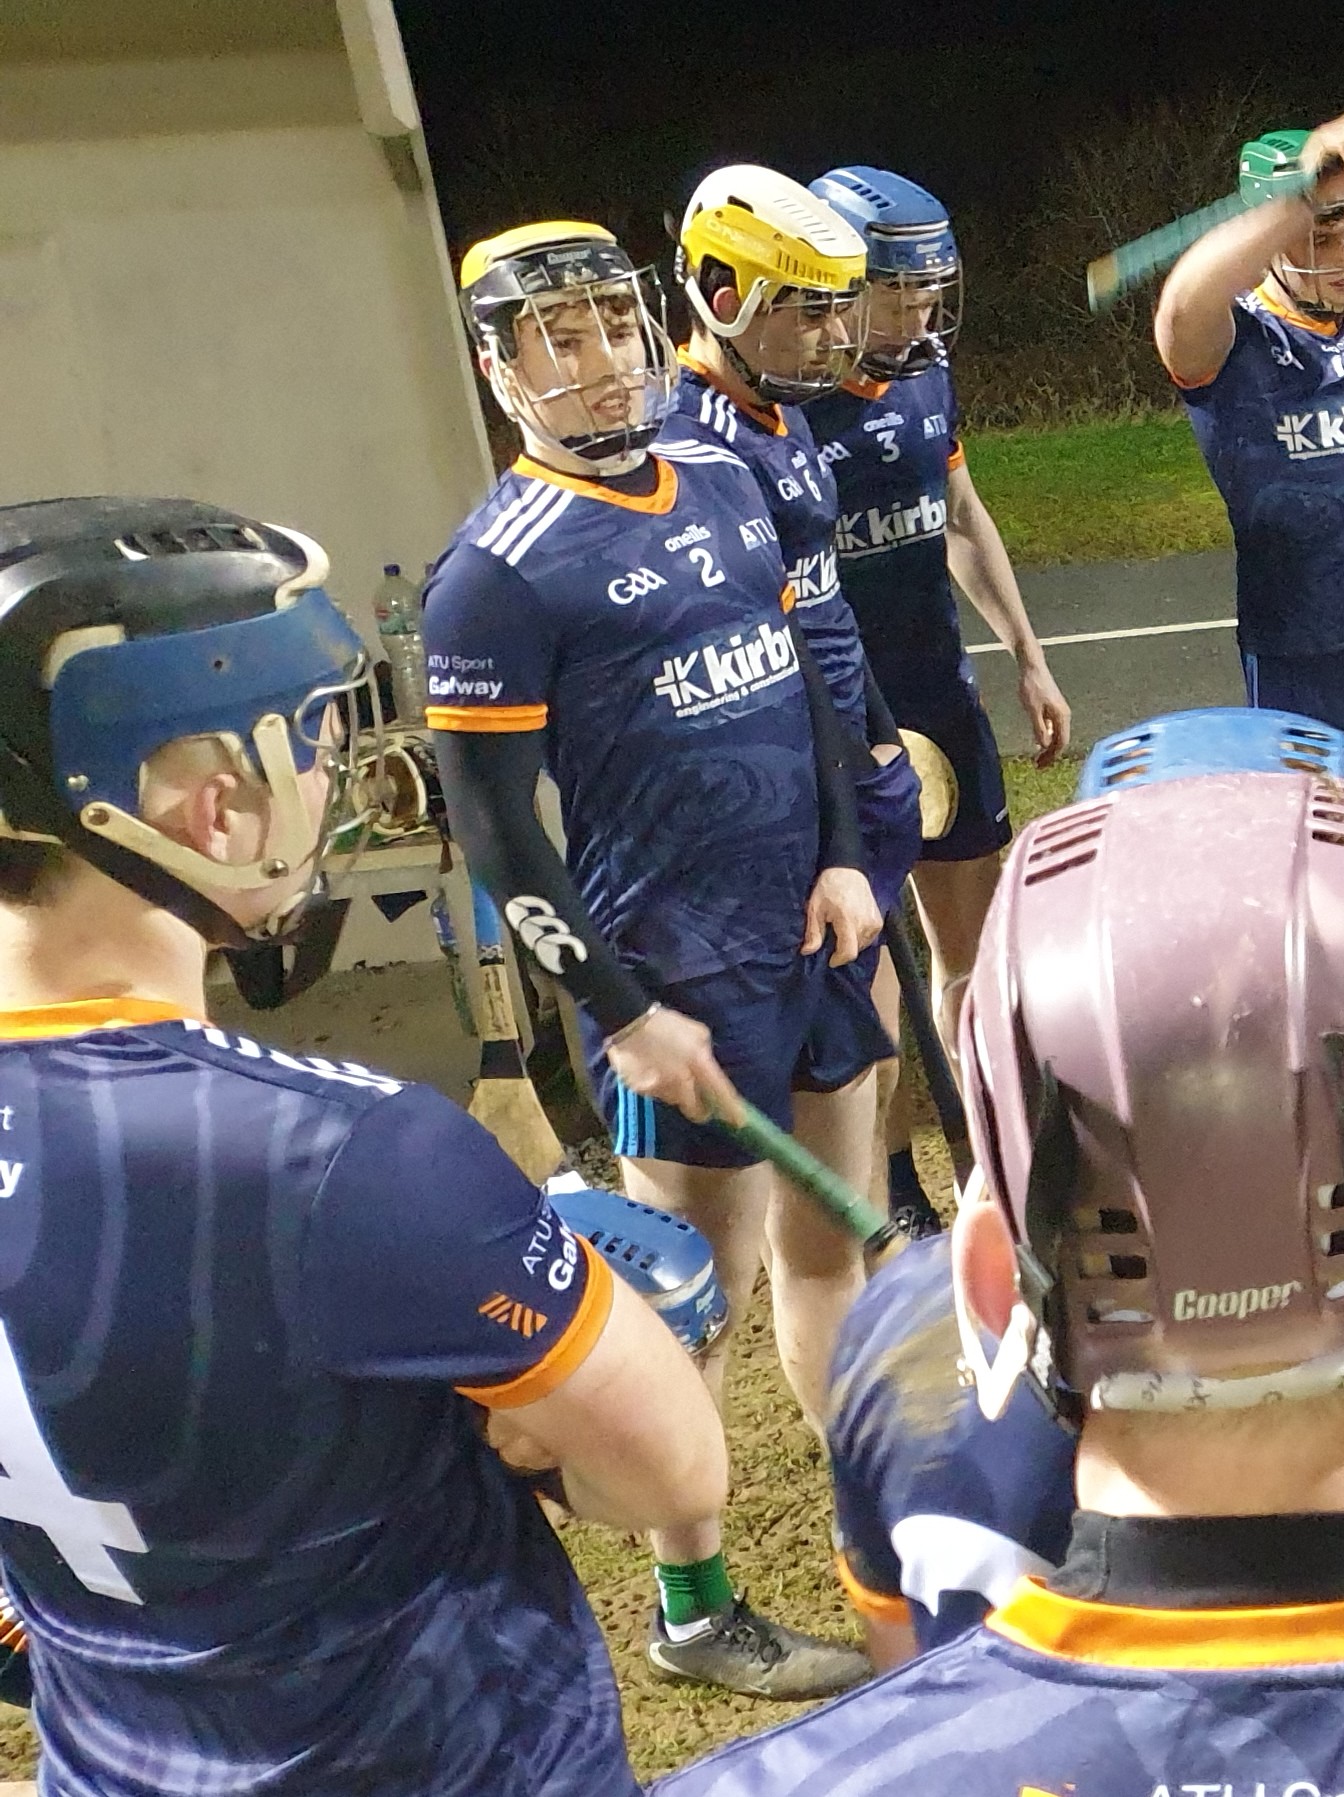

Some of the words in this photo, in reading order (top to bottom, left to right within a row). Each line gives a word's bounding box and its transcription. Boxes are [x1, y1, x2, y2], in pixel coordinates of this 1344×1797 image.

[877, 430, 901, 463] 3
[738, 516, 778, 550] ATU
[689, 547, 726, 588] 2
[429, 675, 503, 700] Galway
[522, 1218, 553, 1275] ATU
[1174, 1280, 1303, 1321] Cooper
